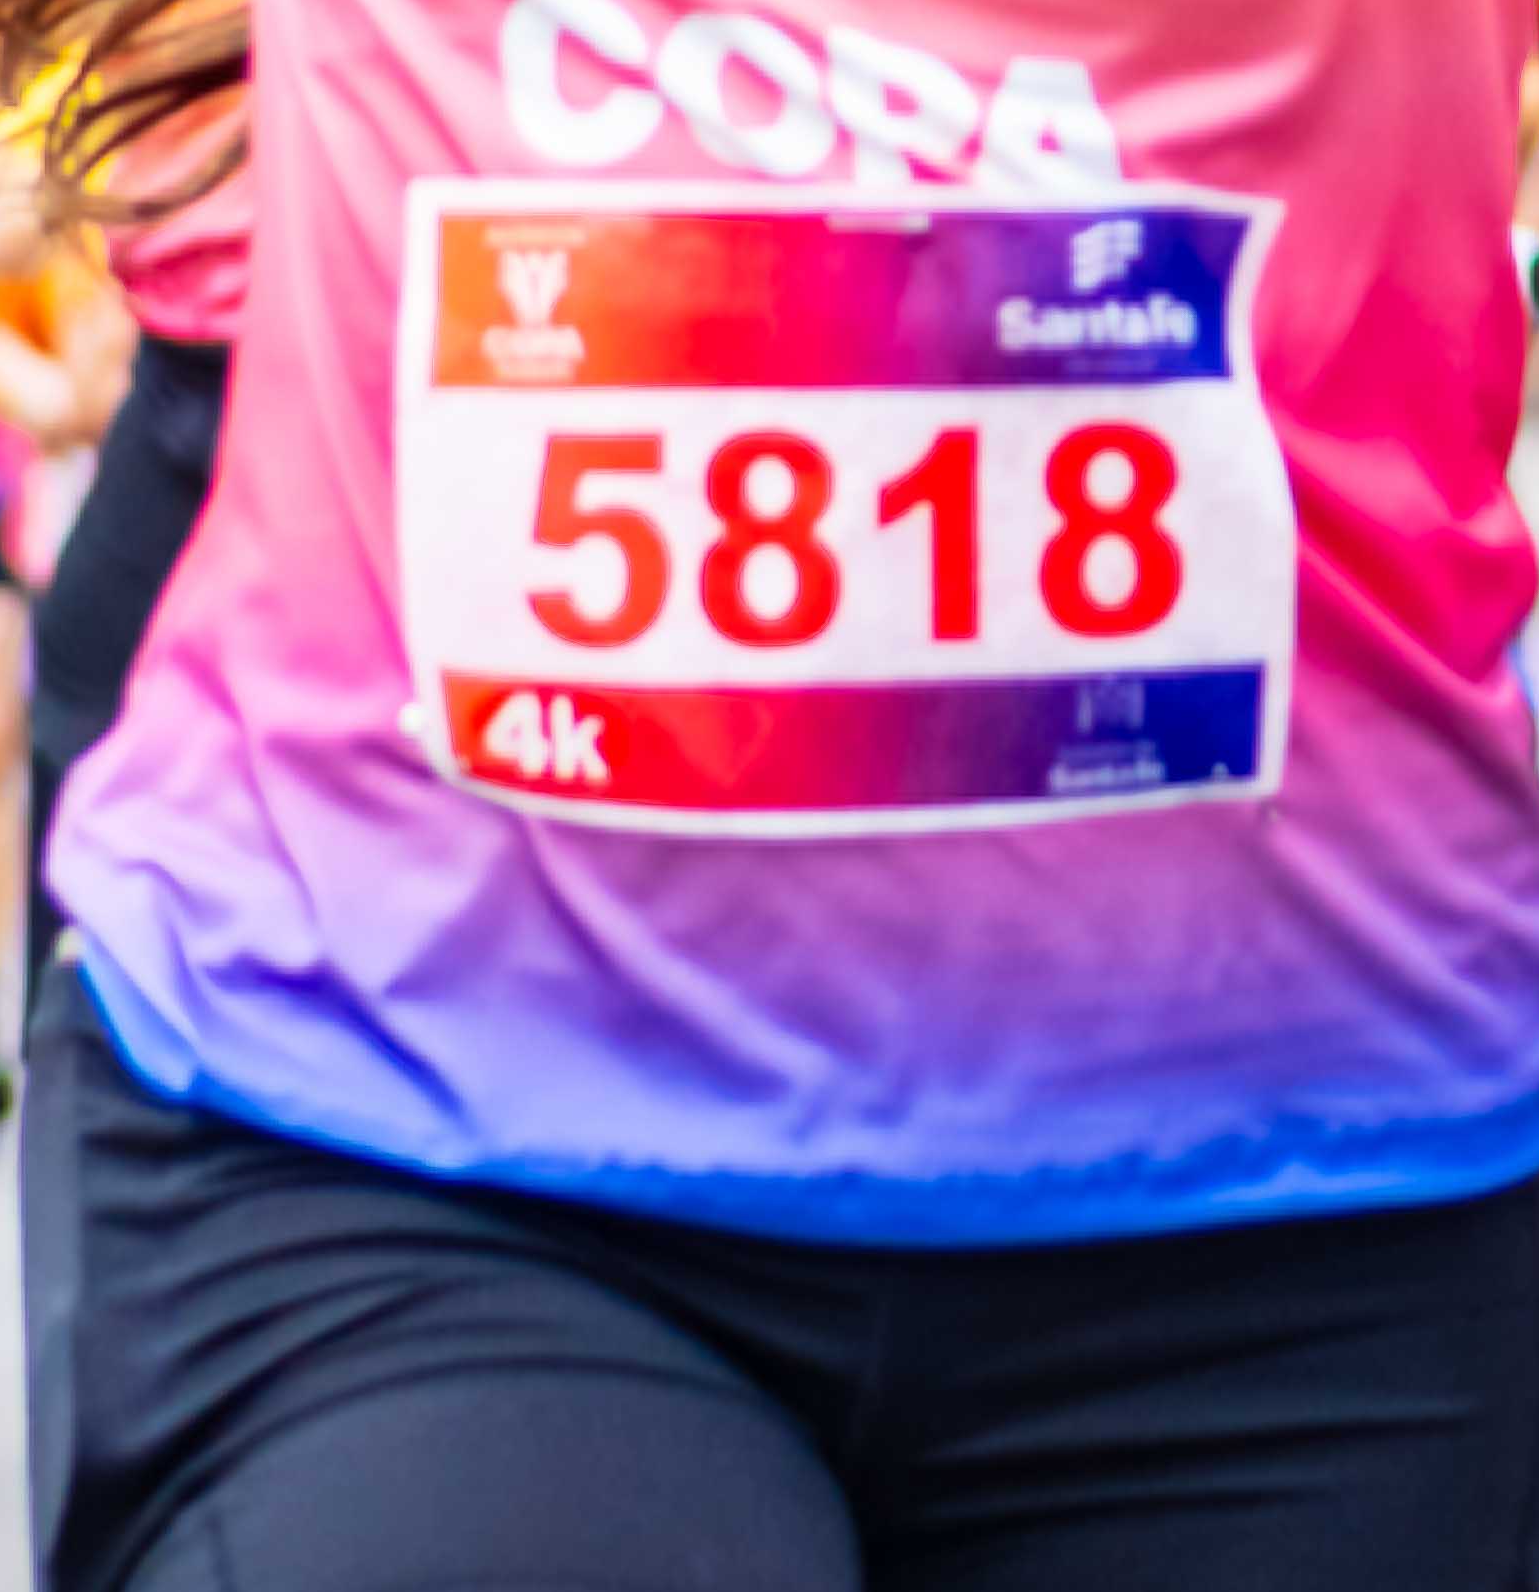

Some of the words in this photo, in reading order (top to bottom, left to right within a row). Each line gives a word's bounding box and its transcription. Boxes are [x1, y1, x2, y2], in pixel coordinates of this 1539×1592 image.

[996, 293, 1148, 354] Santa
[527, 423, 1184, 650] 5818
[483, 690, 611, 788] 4k
